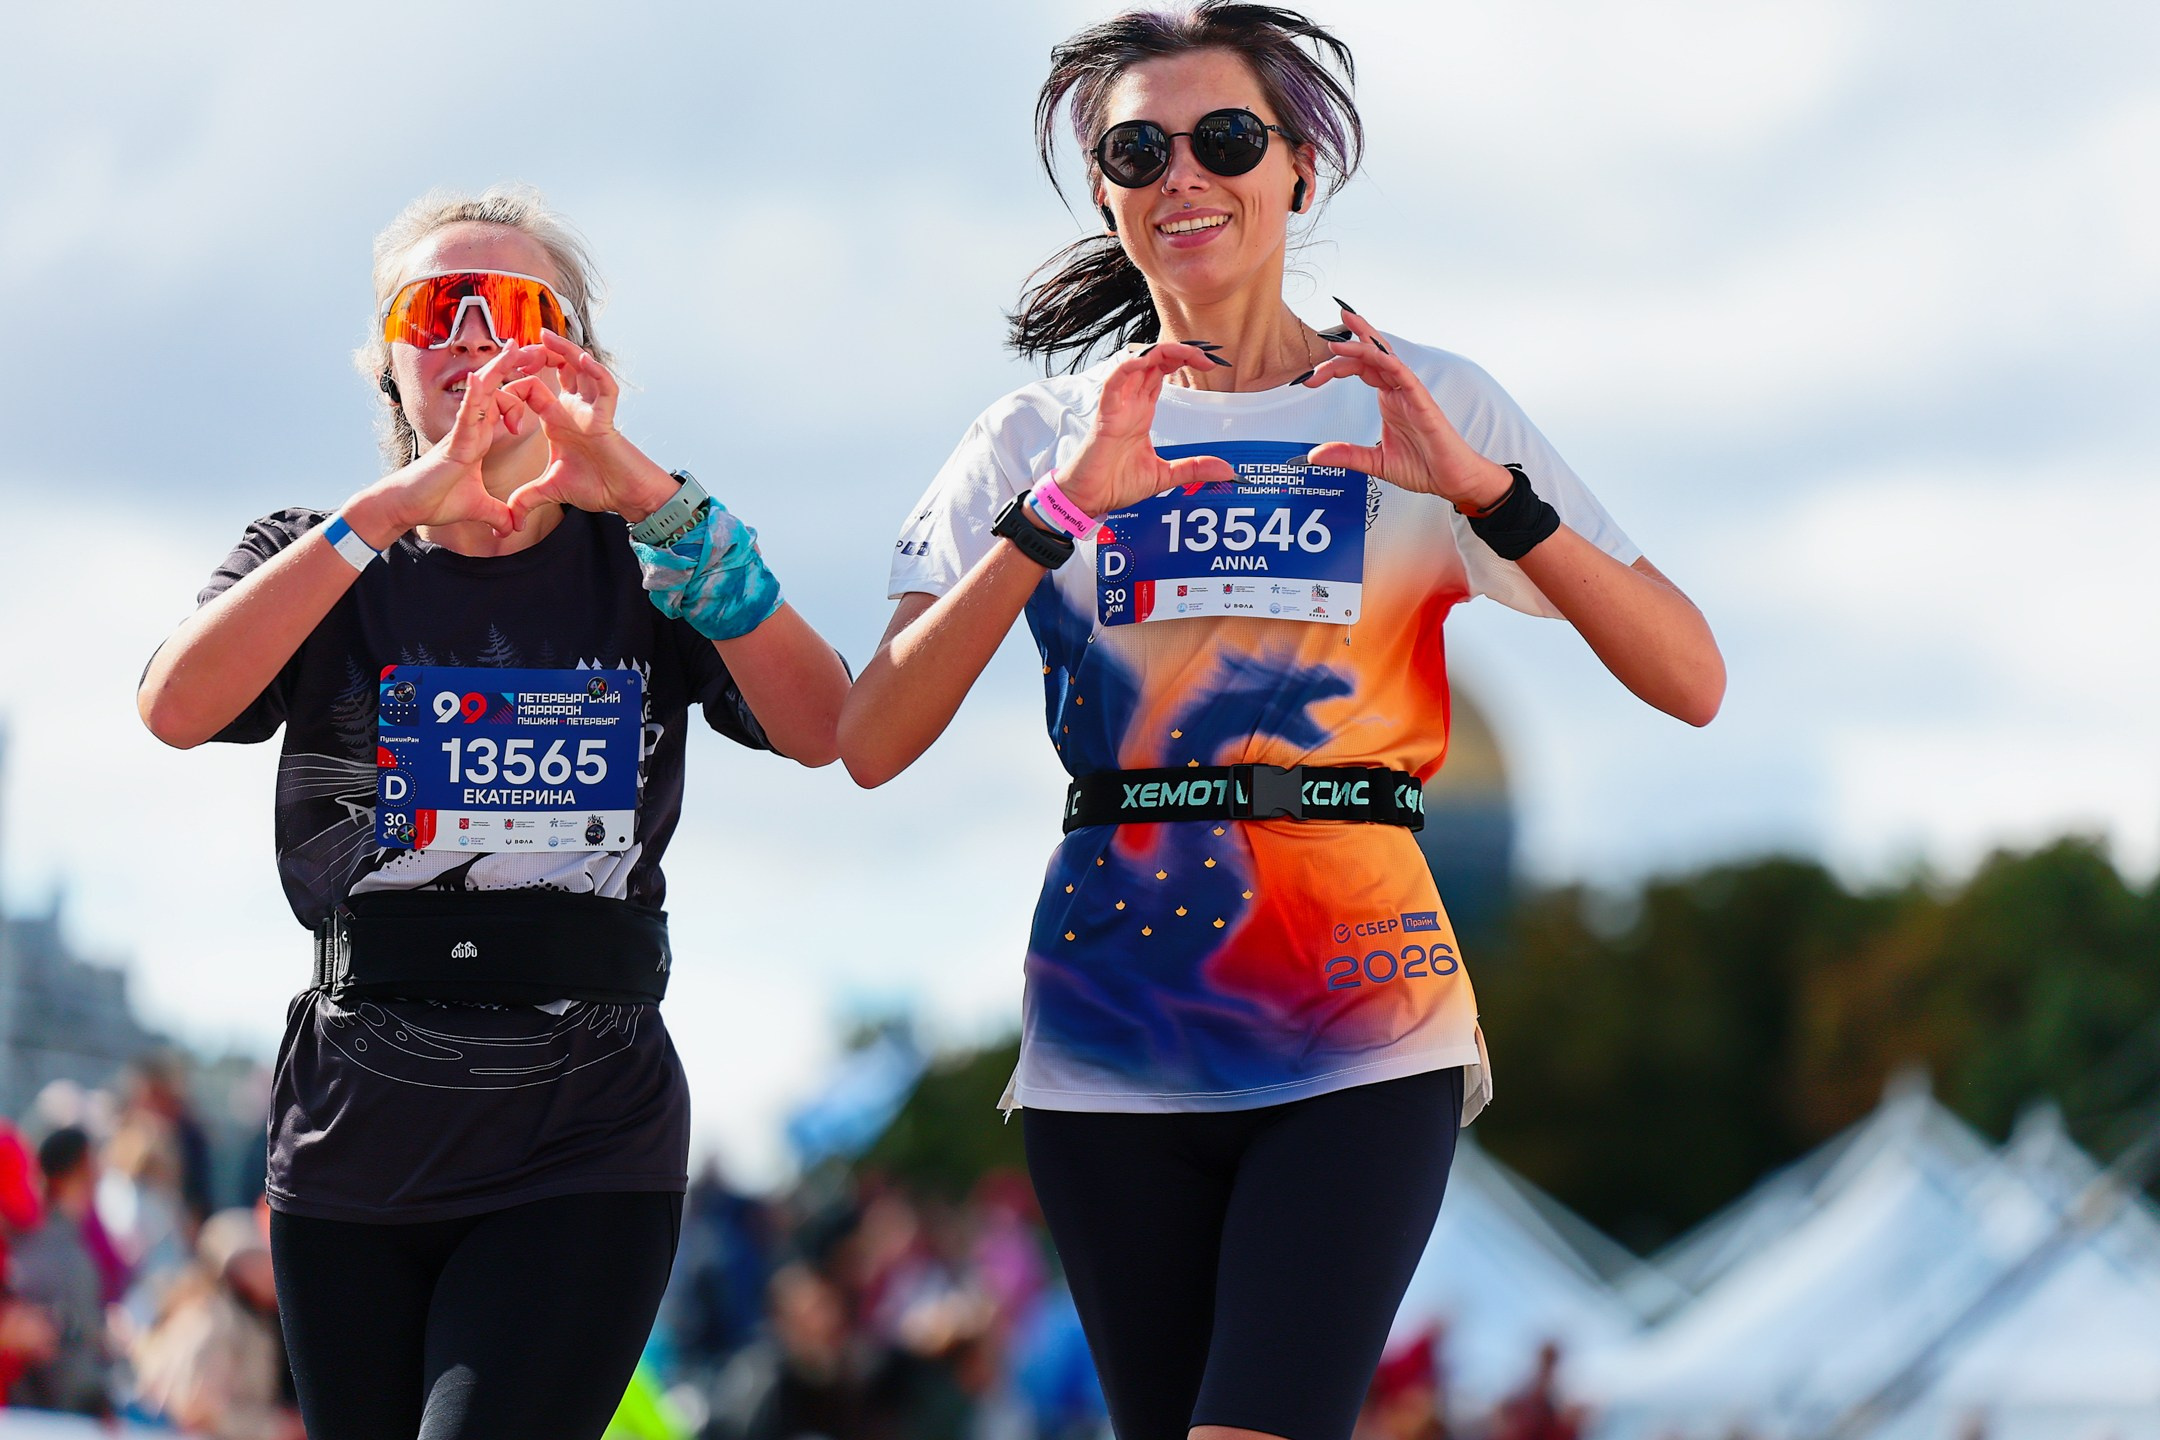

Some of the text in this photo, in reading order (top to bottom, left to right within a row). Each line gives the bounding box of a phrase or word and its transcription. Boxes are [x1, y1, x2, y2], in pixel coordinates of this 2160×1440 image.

[1243, 474, 1305, 485] АРАФОН
[1237, 486, 1345, 497] ПУШКИН ПЕТЕРБУРГ
[1161, 507, 1332, 553] 13546
[1104, 551, 1126, 576] D
[1210, 555, 1269, 571] ANNA
[1105, 588, 1126, 604] 30
[432, 691, 488, 725] 99
[517, 705, 582, 716] МАРАФОН
[517, 717, 620, 726] ПУШКИН ПЕТЕРБУРГ
[379, 735, 420, 744] ПушкинРан
[441, 737, 608, 785] 13565
[385, 775, 407, 800] D
[463, 788, 577, 805] ЕКАТЕРИНА
[384, 813, 407, 827] 30
[1355, 917, 1433, 937] СБЕР Прайм
[1324, 943, 1459, 992] 2026
